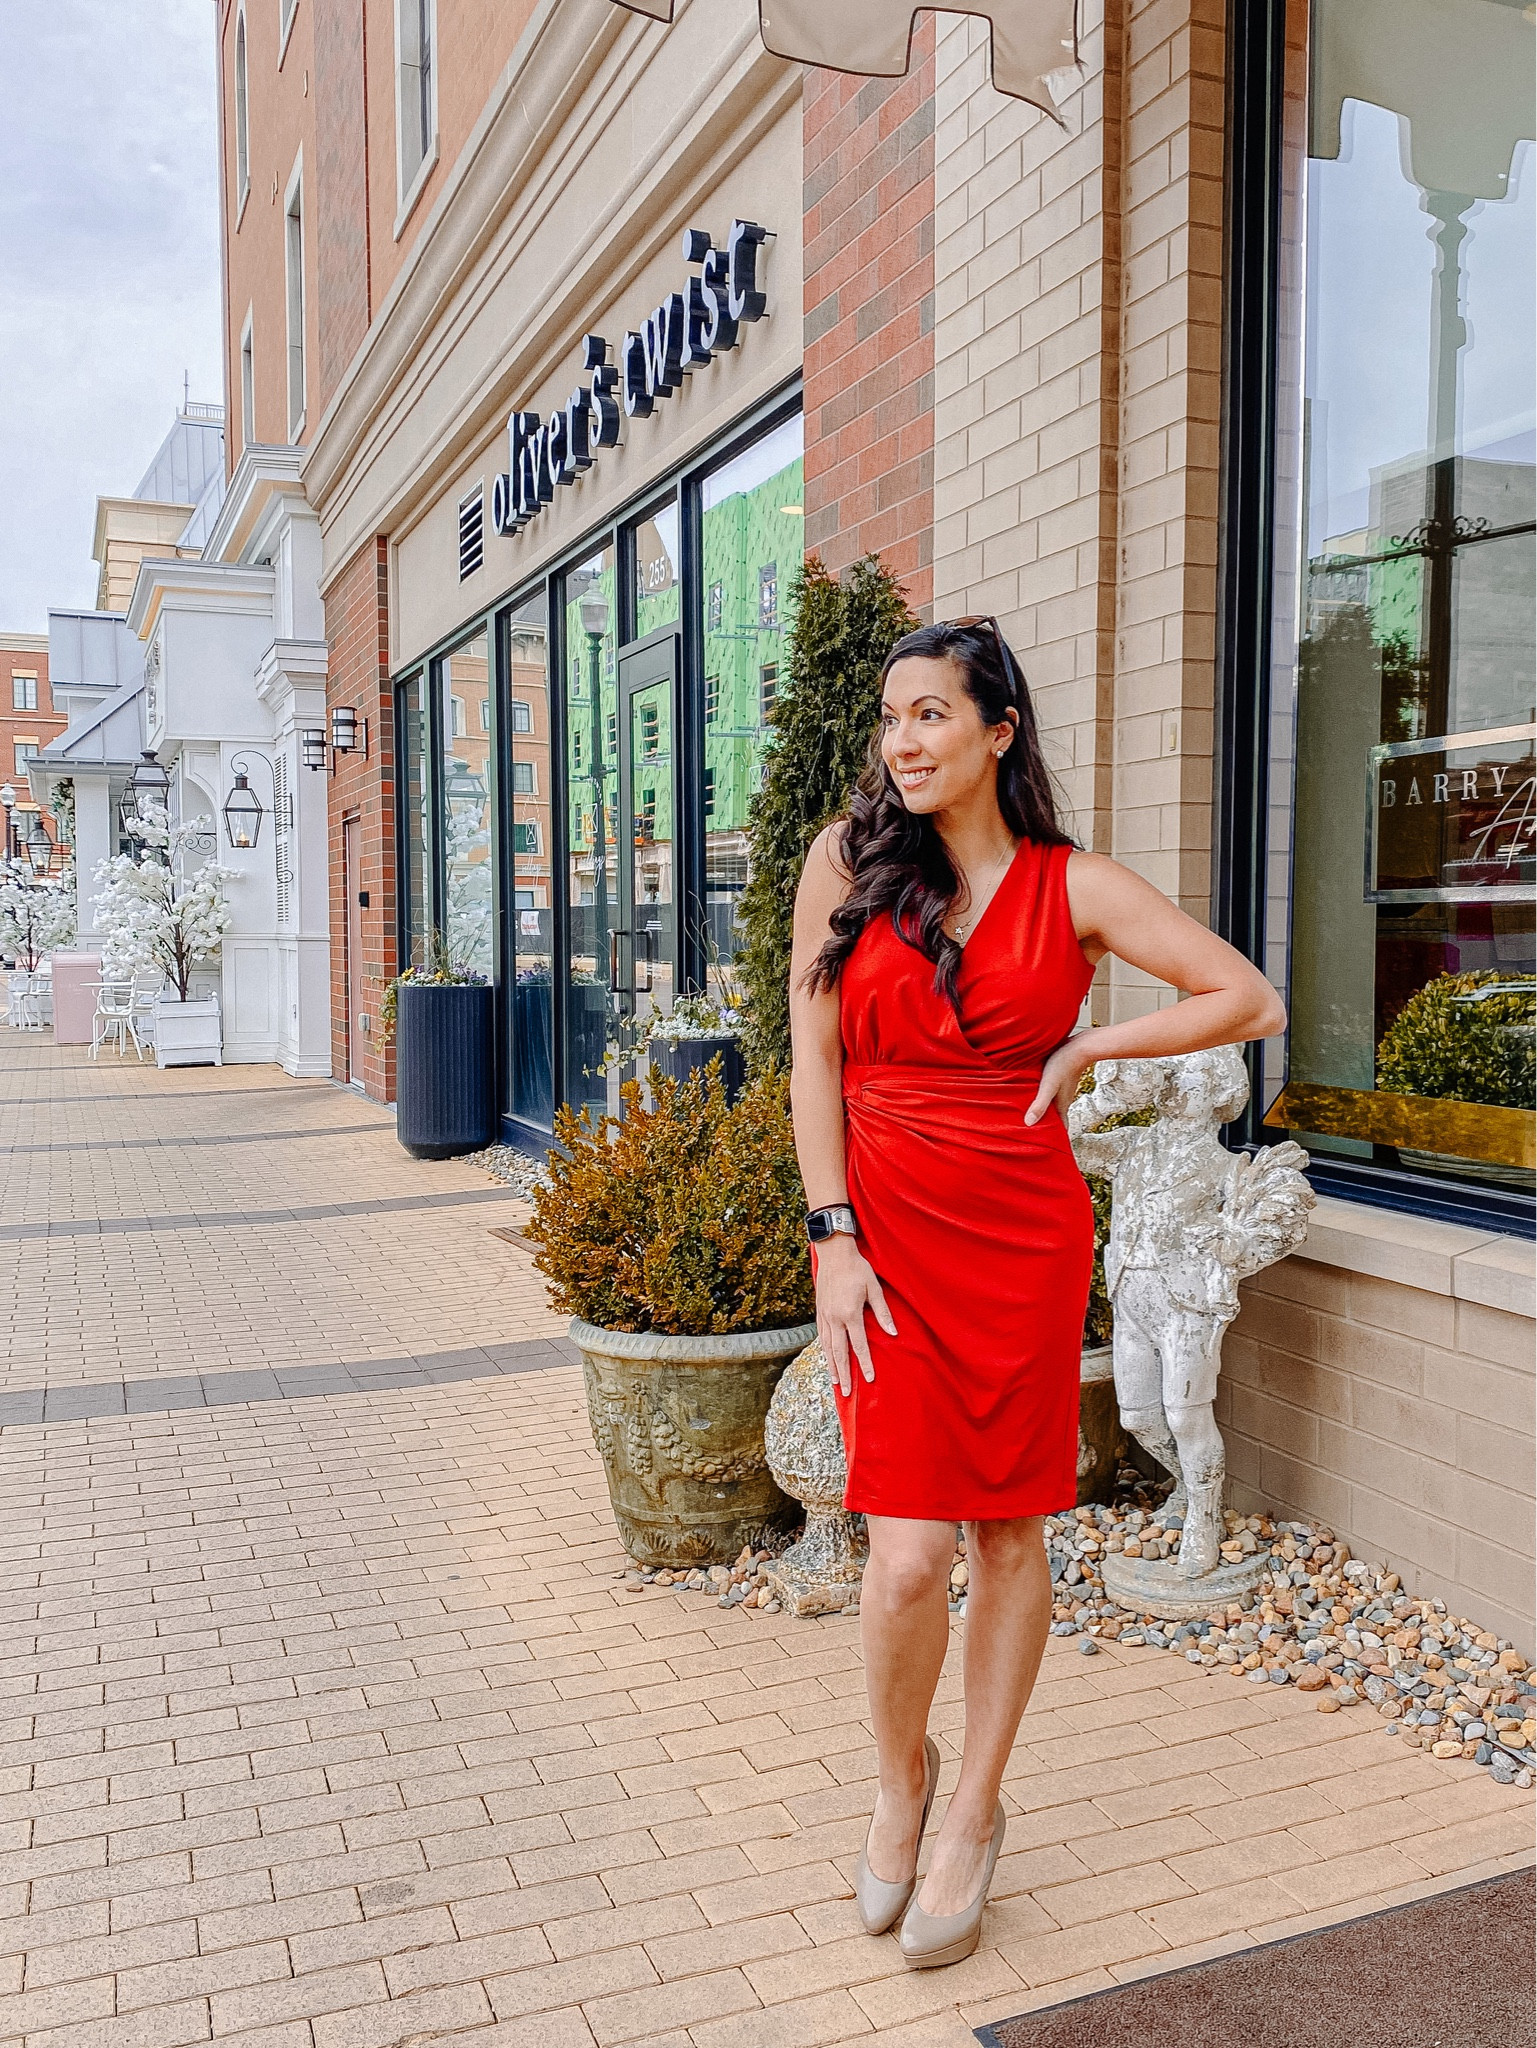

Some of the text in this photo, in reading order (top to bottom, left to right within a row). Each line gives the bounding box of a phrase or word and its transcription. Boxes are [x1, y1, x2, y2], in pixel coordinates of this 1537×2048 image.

[492, 218, 766, 537] oliver's twist
[649, 556, 666, 588] 255
[1381, 766, 1509, 808] BARRY
